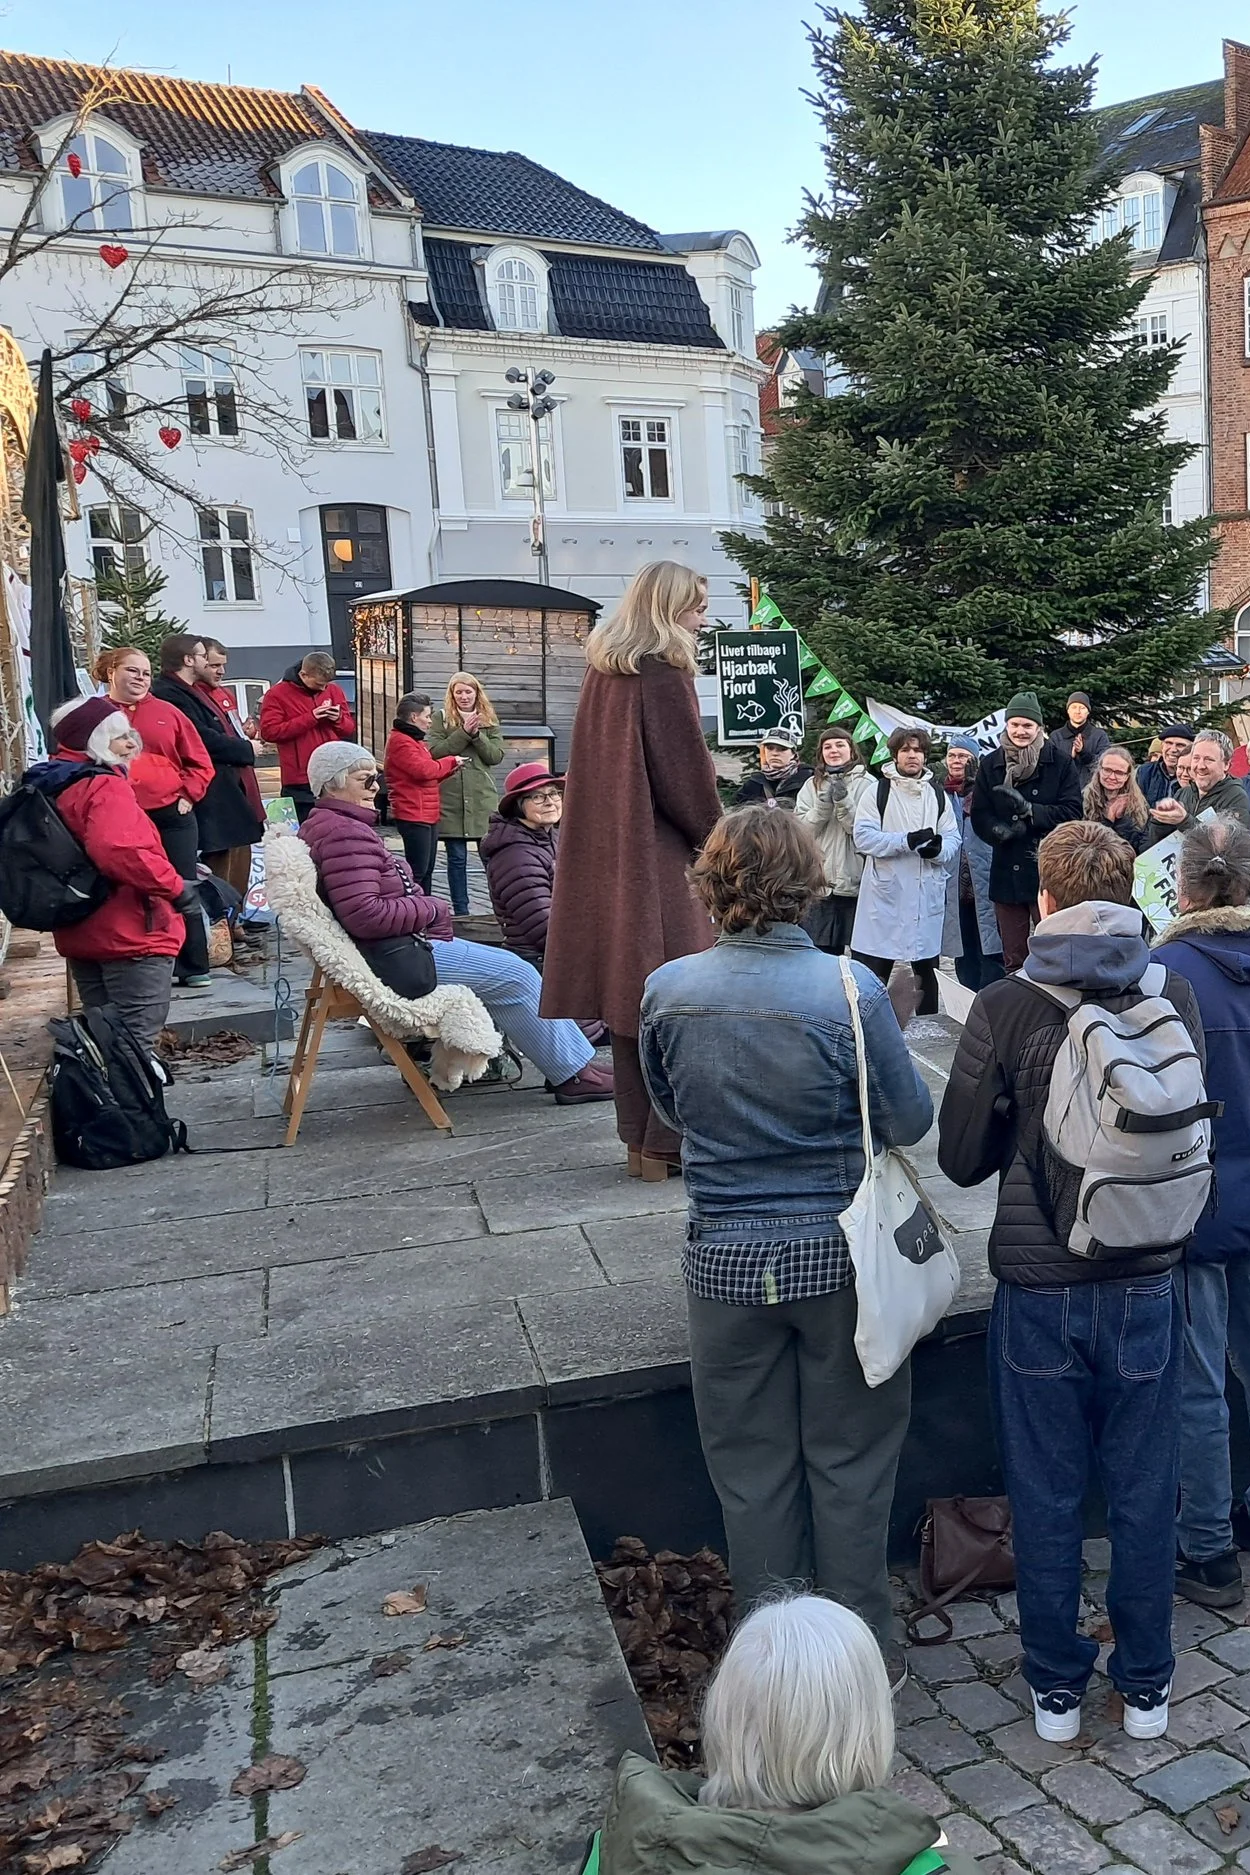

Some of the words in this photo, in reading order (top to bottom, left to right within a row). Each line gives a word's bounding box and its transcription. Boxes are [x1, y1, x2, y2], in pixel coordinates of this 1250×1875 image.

[720, 644, 745, 657] Livet
[746, 643, 781, 658] tilbage
[782, 643, 787, 656] i
[721, 660, 777, 679] Hjarbæk
[723, 679, 756, 699] Fjord
